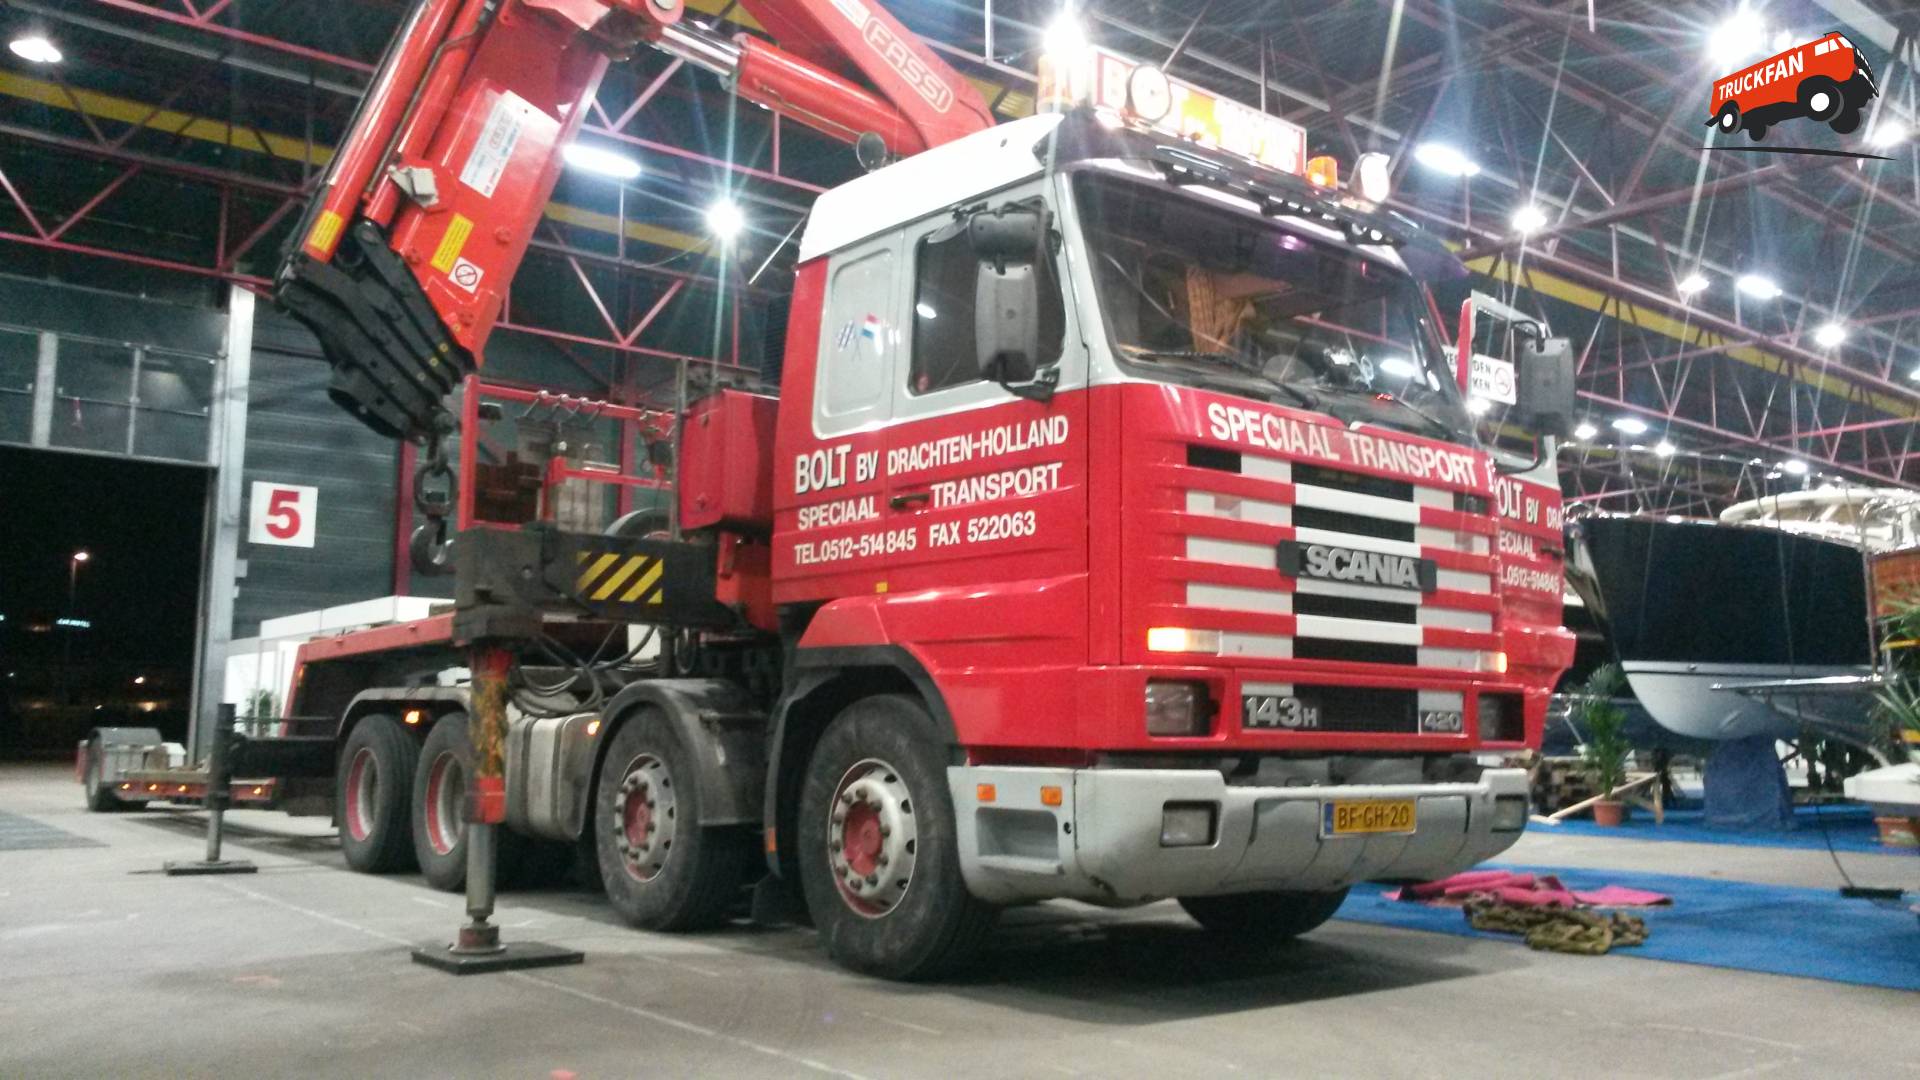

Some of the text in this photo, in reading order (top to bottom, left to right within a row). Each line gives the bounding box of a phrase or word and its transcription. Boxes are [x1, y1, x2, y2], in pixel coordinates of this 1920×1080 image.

[869, 25, 947, 107] FASSI
[795, 415, 1069, 493] BOLT BV DRACHTEN-HOLLAND
[1208, 403, 1476, 487] SPECIAAL TRANSPORT
[266, 489, 301, 539] 5
[798, 462, 1062, 530] SPECIAAL TRANSPORT
[1526, 497, 1539, 524] BV
[929, 521, 960, 547] FAX
[968, 510, 1036, 543] 522063
[1499, 529, 1536, 561] ECIAAL
[1307, 544, 1419, 589] SCANIA
[1424, 712, 1461, 731] 420
[1338, 804, 1410, 829] BF-GH-20
